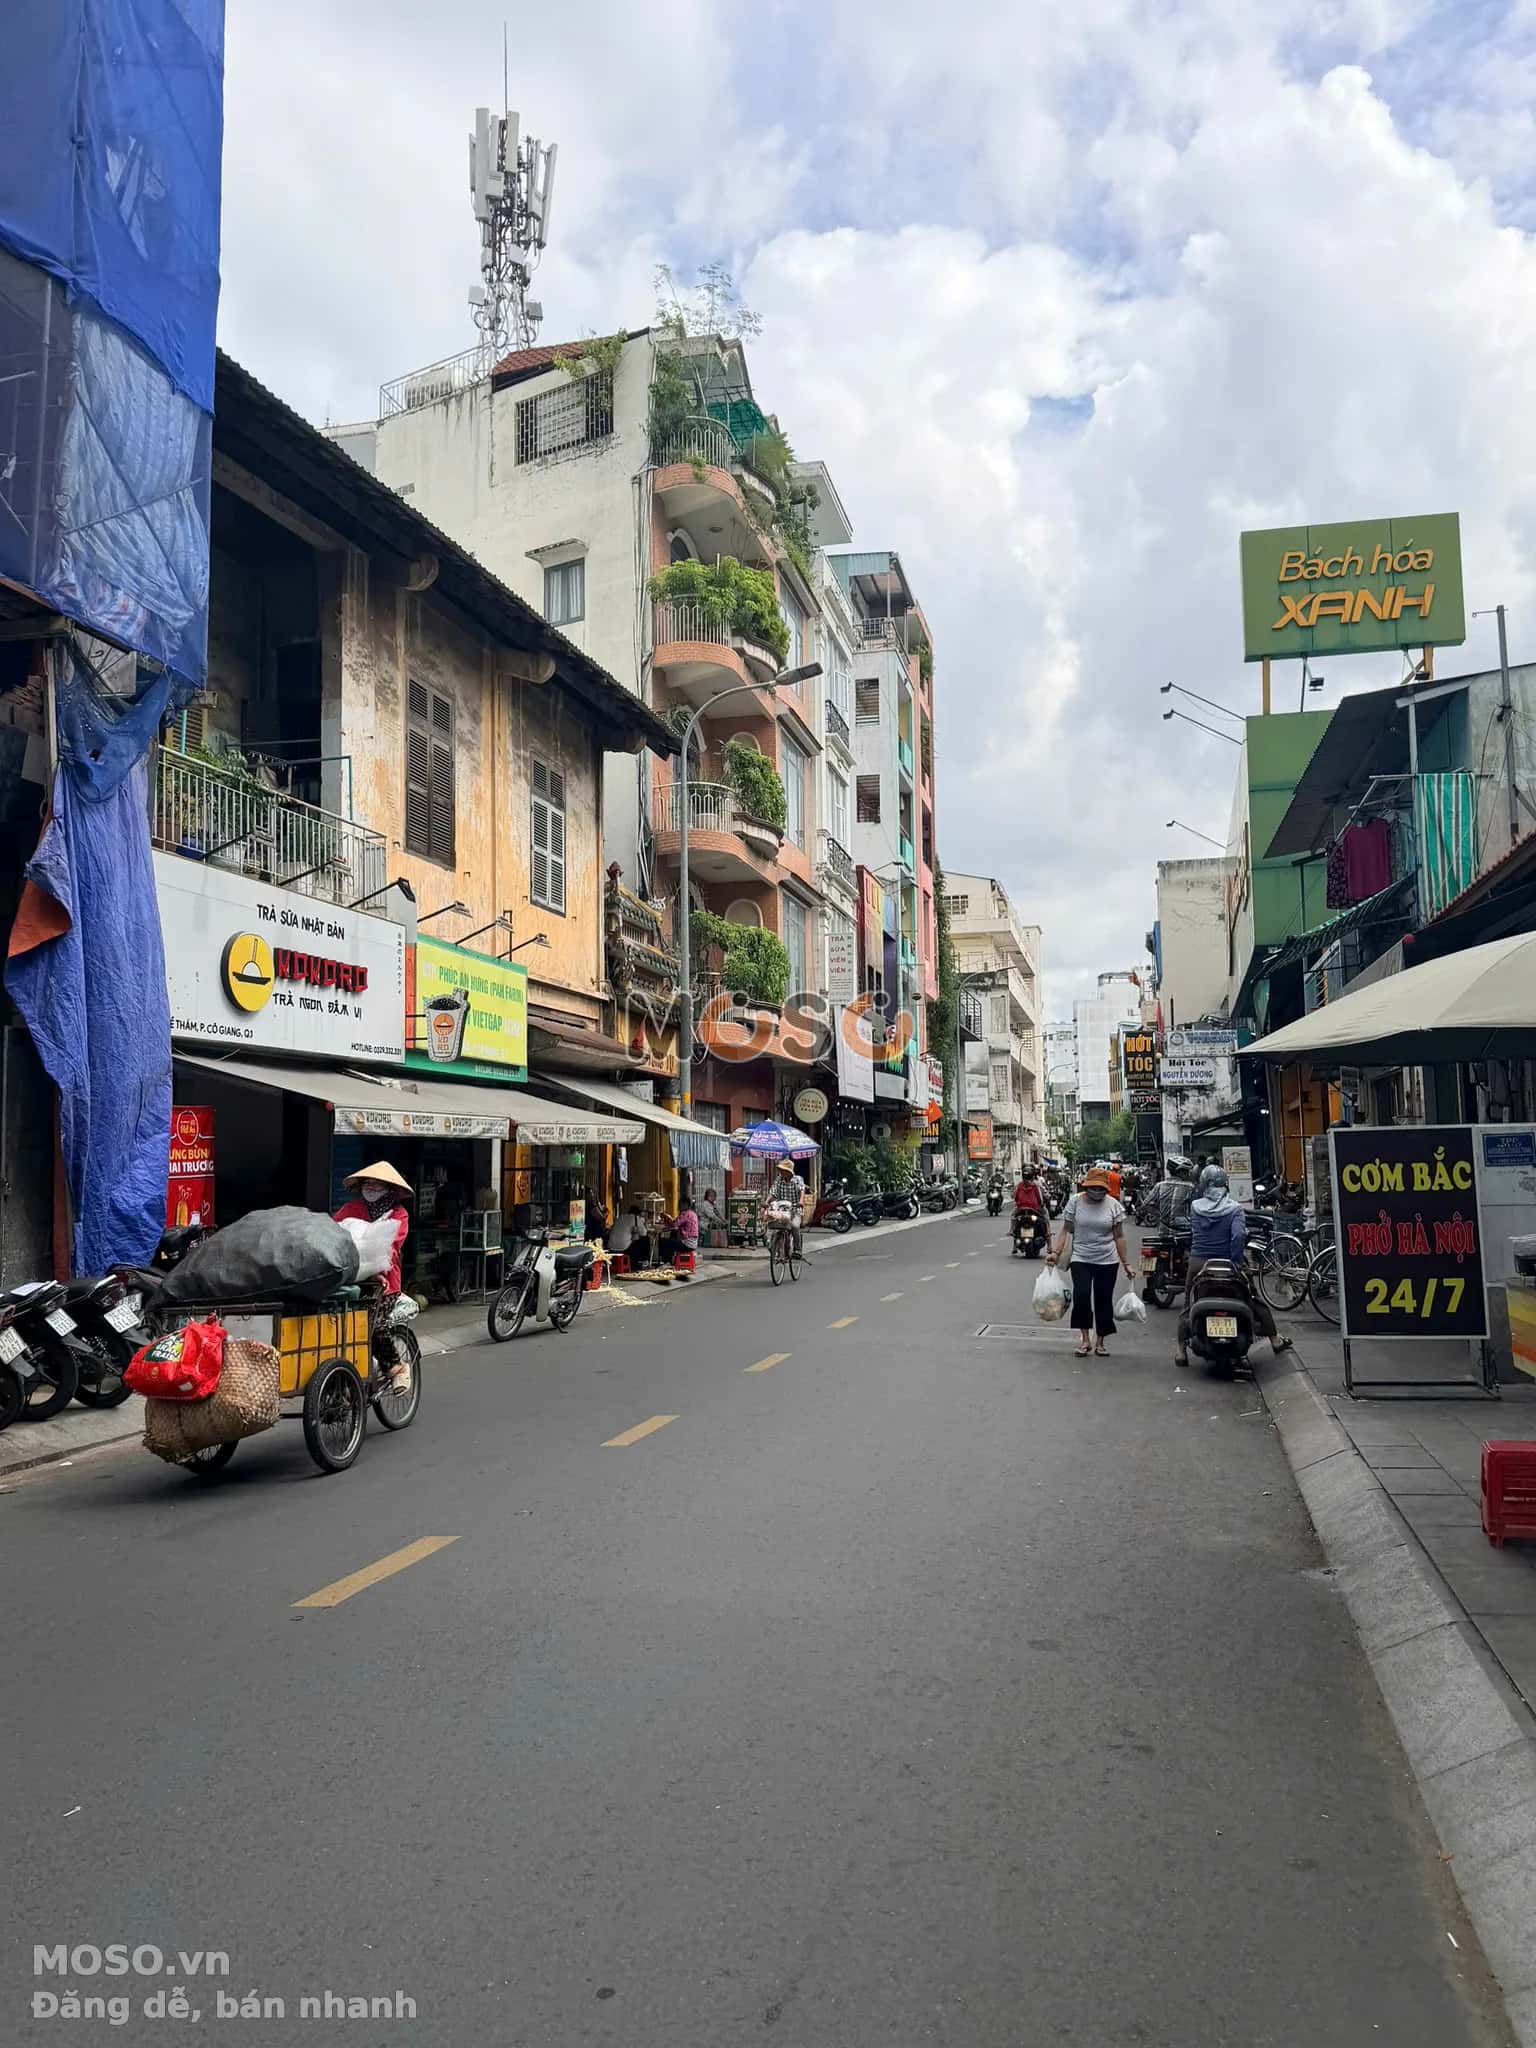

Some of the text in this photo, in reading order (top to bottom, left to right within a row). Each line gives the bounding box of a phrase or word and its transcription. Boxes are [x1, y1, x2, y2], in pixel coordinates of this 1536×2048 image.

[1278, 538, 1433, 583] Bách hóa
[1272, 583, 1435, 630] XANH
[257, 904, 276, 923] TRÀ
[281, 909, 298, 928] SỮA
[301, 917, 325, 936] NHẬT
[274, 948, 368, 992] KOKORO
[273, 990, 294, 1007] TRÀ
[1342, 1158, 1405, 1193] CƠM
[1412, 1145, 1472, 1192] BẮC
[1347, 1209, 1475, 1263] PHỞ HÀ NỘI
[1364, 1278, 1465, 1318] 24/7
